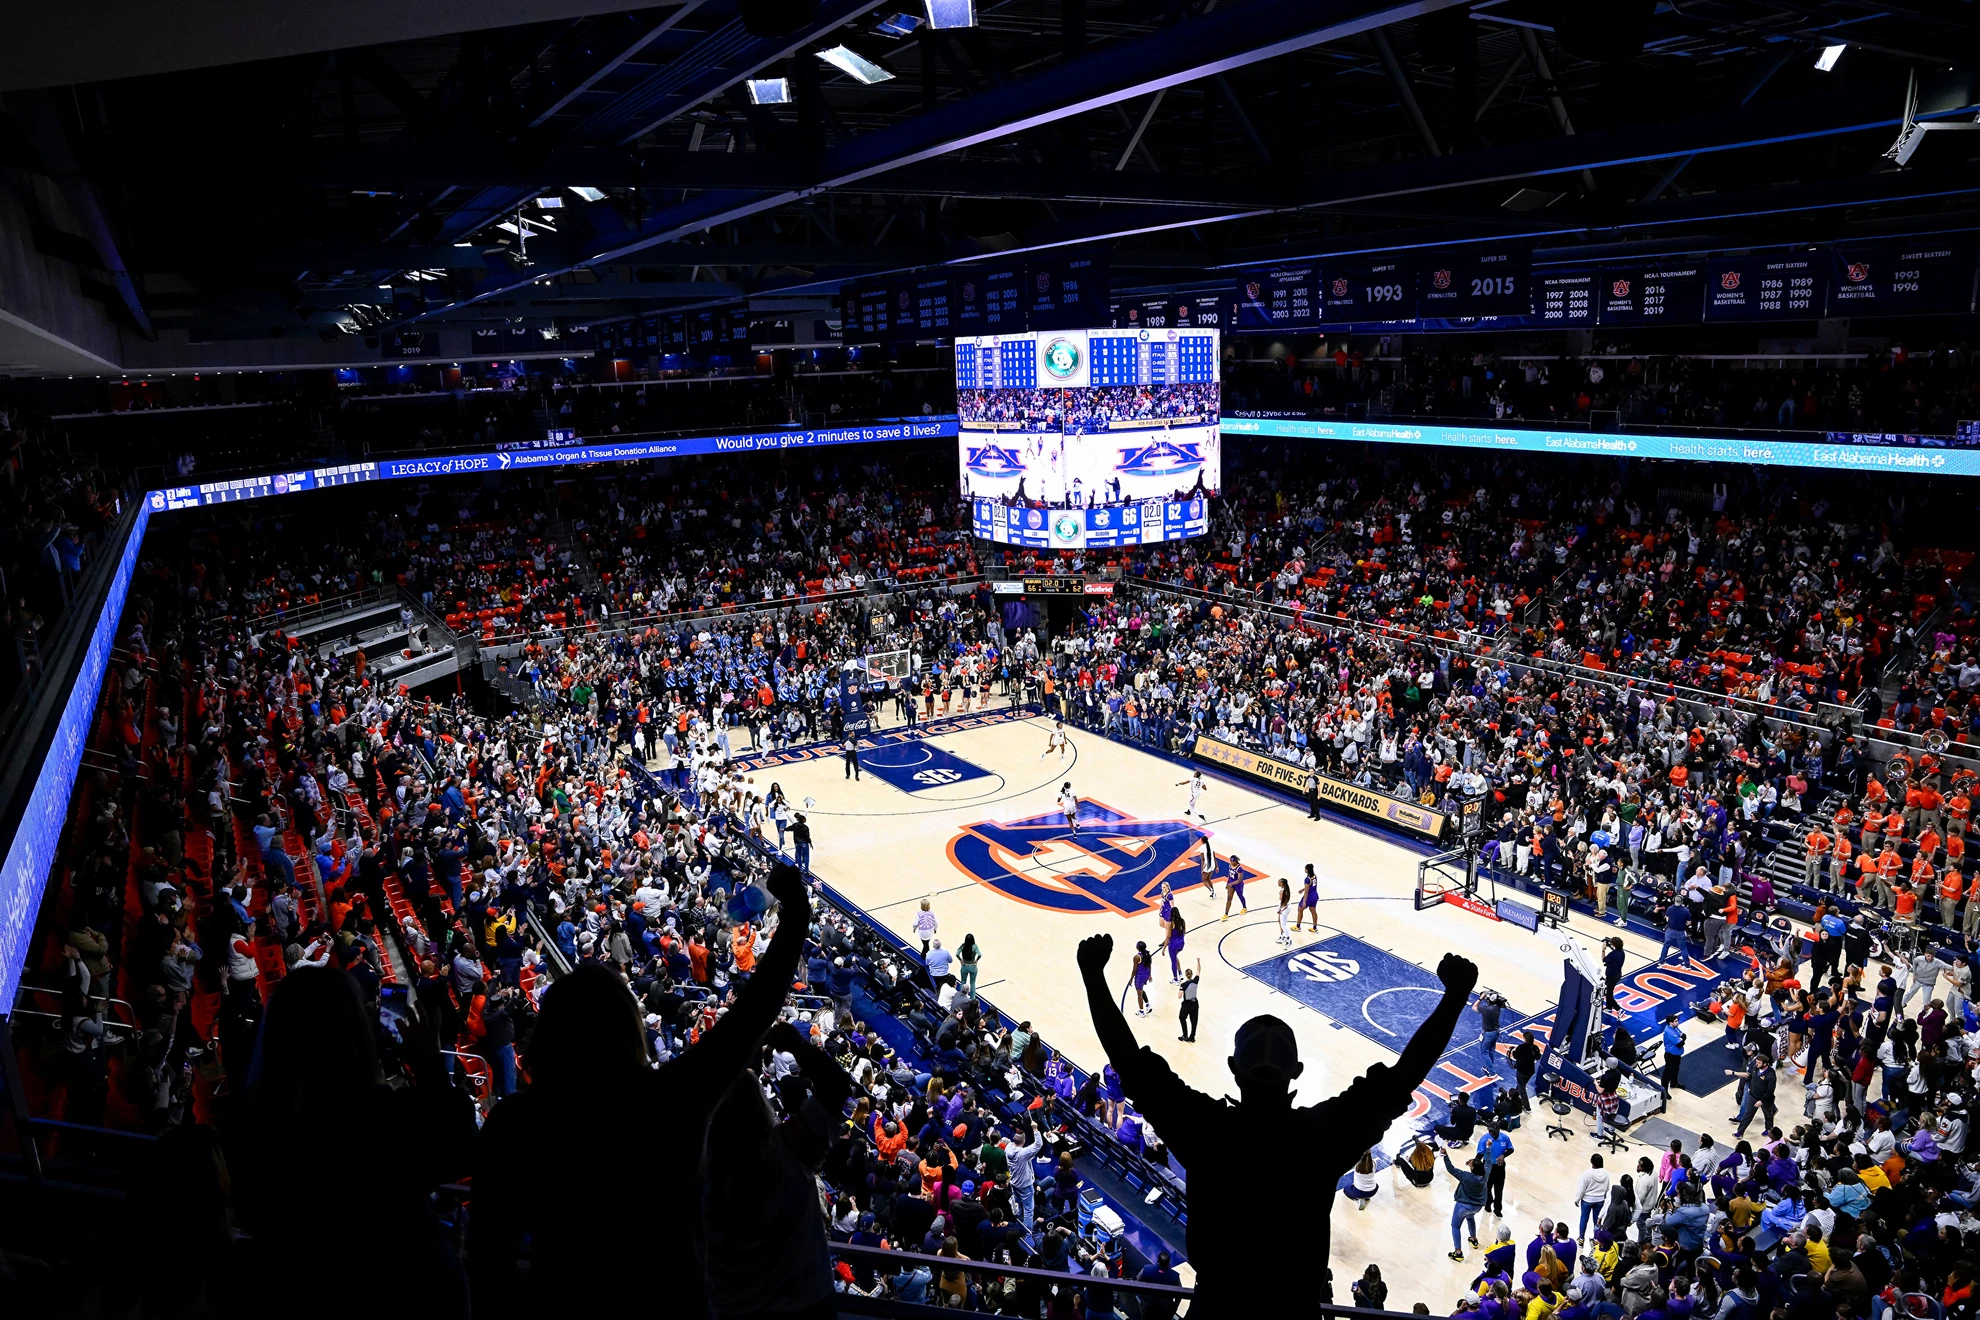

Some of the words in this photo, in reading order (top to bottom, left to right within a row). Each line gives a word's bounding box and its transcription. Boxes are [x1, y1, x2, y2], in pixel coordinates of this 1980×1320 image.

[1924, 251, 1951, 259] SIXTEEN
[1894, 271, 1920, 280] 1993
[1062, 280, 1078, 291] 1986
[1471, 277, 1514, 297] 2015
[1762, 280, 1783, 289] 1986
[1790, 278, 1813, 287] 1989
[1893, 282, 1919, 292] 1996
[1273, 290, 1287, 298] 1991
[1293, 288, 1308, 296] 2015
[1366, 285, 1403, 303] 1993
[1546, 292, 1564, 300] 1997
[1570, 290, 1589, 299] 2004
[1645, 286, 1665, 294] 2016
[1761, 291, 1782, 300] 1987
[1790, 289, 1812, 298] 1990
[1063, 293, 1079, 303] 2019
[1427, 292, 1457, 300] GYMNASTICS
[1644, 296, 1664, 305] 2017
[1272, 300, 1288, 309] 1993
[1293, 299, 1309, 307] 2016
[1546, 301, 1563, 309] 1999
[1569, 300, 1588, 308] 2008
[1760, 302, 1781, 310] 1988
[1789, 300, 1809, 309] 1991
[1272, 310, 1290, 319] 2003
[1293, 308, 1311, 317] 2022
[1544, 311, 1563, 319] 2000
[1568, 310, 1588, 318] 2009
[1644, 306, 1664, 315] 2019
[1146, 316, 1165, 327] 1989
[1198, 313, 1218, 324] 1990
[402, 347, 421, 355] 2019
[1276, 424, 1296, 433] Health
[1298, 426, 1316, 434] starts
[1318, 426, 1336, 435] here.
[716, 437, 753, 449] Would
[756, 436, 777, 449] you
[780, 433, 804, 448] give
[807, 432, 815, 443] 2
[818, 430, 860, 442] minutes
[863, 429, 873, 440] to
[876, 428, 900, 439] save
[904, 426, 911, 437] 8
[913, 424, 942, 436] lives?
[1442, 432, 1466, 442] Health
[1470, 434, 1492, 443] starts
[1496, 434, 1518, 445] here.
[514, 453, 554, 464] Alabama's
[556, 452, 580, 462] Organ
[581, 451, 587, 459] &
[589, 450, 613, 458] Tissue
[614, 448, 647, 456] Donation
[649, 446, 677, 454] Alliance
[1670, 443, 1704, 455] Health
[1708, 446, 1738, 457] starts
[1743, 446, 1775, 459] here.
[392, 462, 442, 476] LEGACY
[442, 460, 454, 473] of
[456, 458, 489, 471] HOPE
[1123, 508, 1137, 525] 66
[1145, 505, 1161, 519] 02.0
[1168, 504, 1181, 520] 62
[1256, 761, 1273, 777] FOR
[1274, 767, 1319, 790] FIVE-ST
[1321, 783, 1380, 813] BACKYARDS.
[1464, 802, 1479, 815] 02.0
[1048, 1067, 1057, 1078] 13
